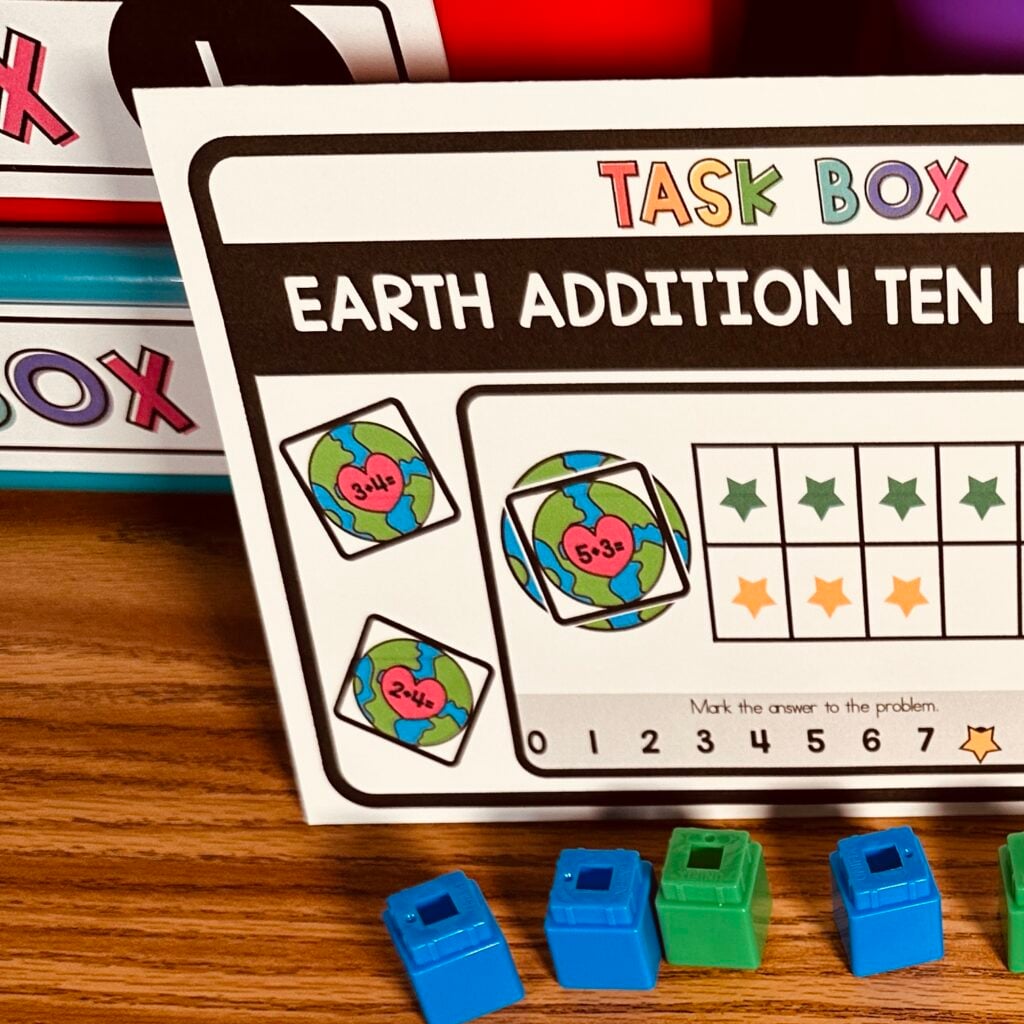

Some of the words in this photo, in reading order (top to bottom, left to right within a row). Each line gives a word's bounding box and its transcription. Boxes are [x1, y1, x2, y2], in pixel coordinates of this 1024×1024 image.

[598, 157, 783, 229] TASK
[813, 156, 970, 226] BOX
[283, 271, 495, 333] EARTH
[519, 267, 852, 329] ADDITION
[875, 265, 993, 327] TEN
[0, 344, 199, 435] OX
[350, 473, 395, 502] 3+4=
[575, 539, 625, 564] 5+3=
[388, 682, 434, 710] 2+4=
[690, 698, 732, 714] Mark
[738, 698, 763, 714] the
[768, 702, 818, 714] answer
[824, 700, 840, 714] to
[846, 697, 870, 714] the
[875, 696, 940, 719] problem.
[527, 730, 547, 755] 0
[588, 729, 599, 755] 1
[641, 729, 661, 754] 2
[696, 729, 715, 754] 3
[750, 729, 771, 754] 4
[807, 728, 826, 754] 5
[862, 728, 882, 752] 6
[917, 727, 935, 752] 7
